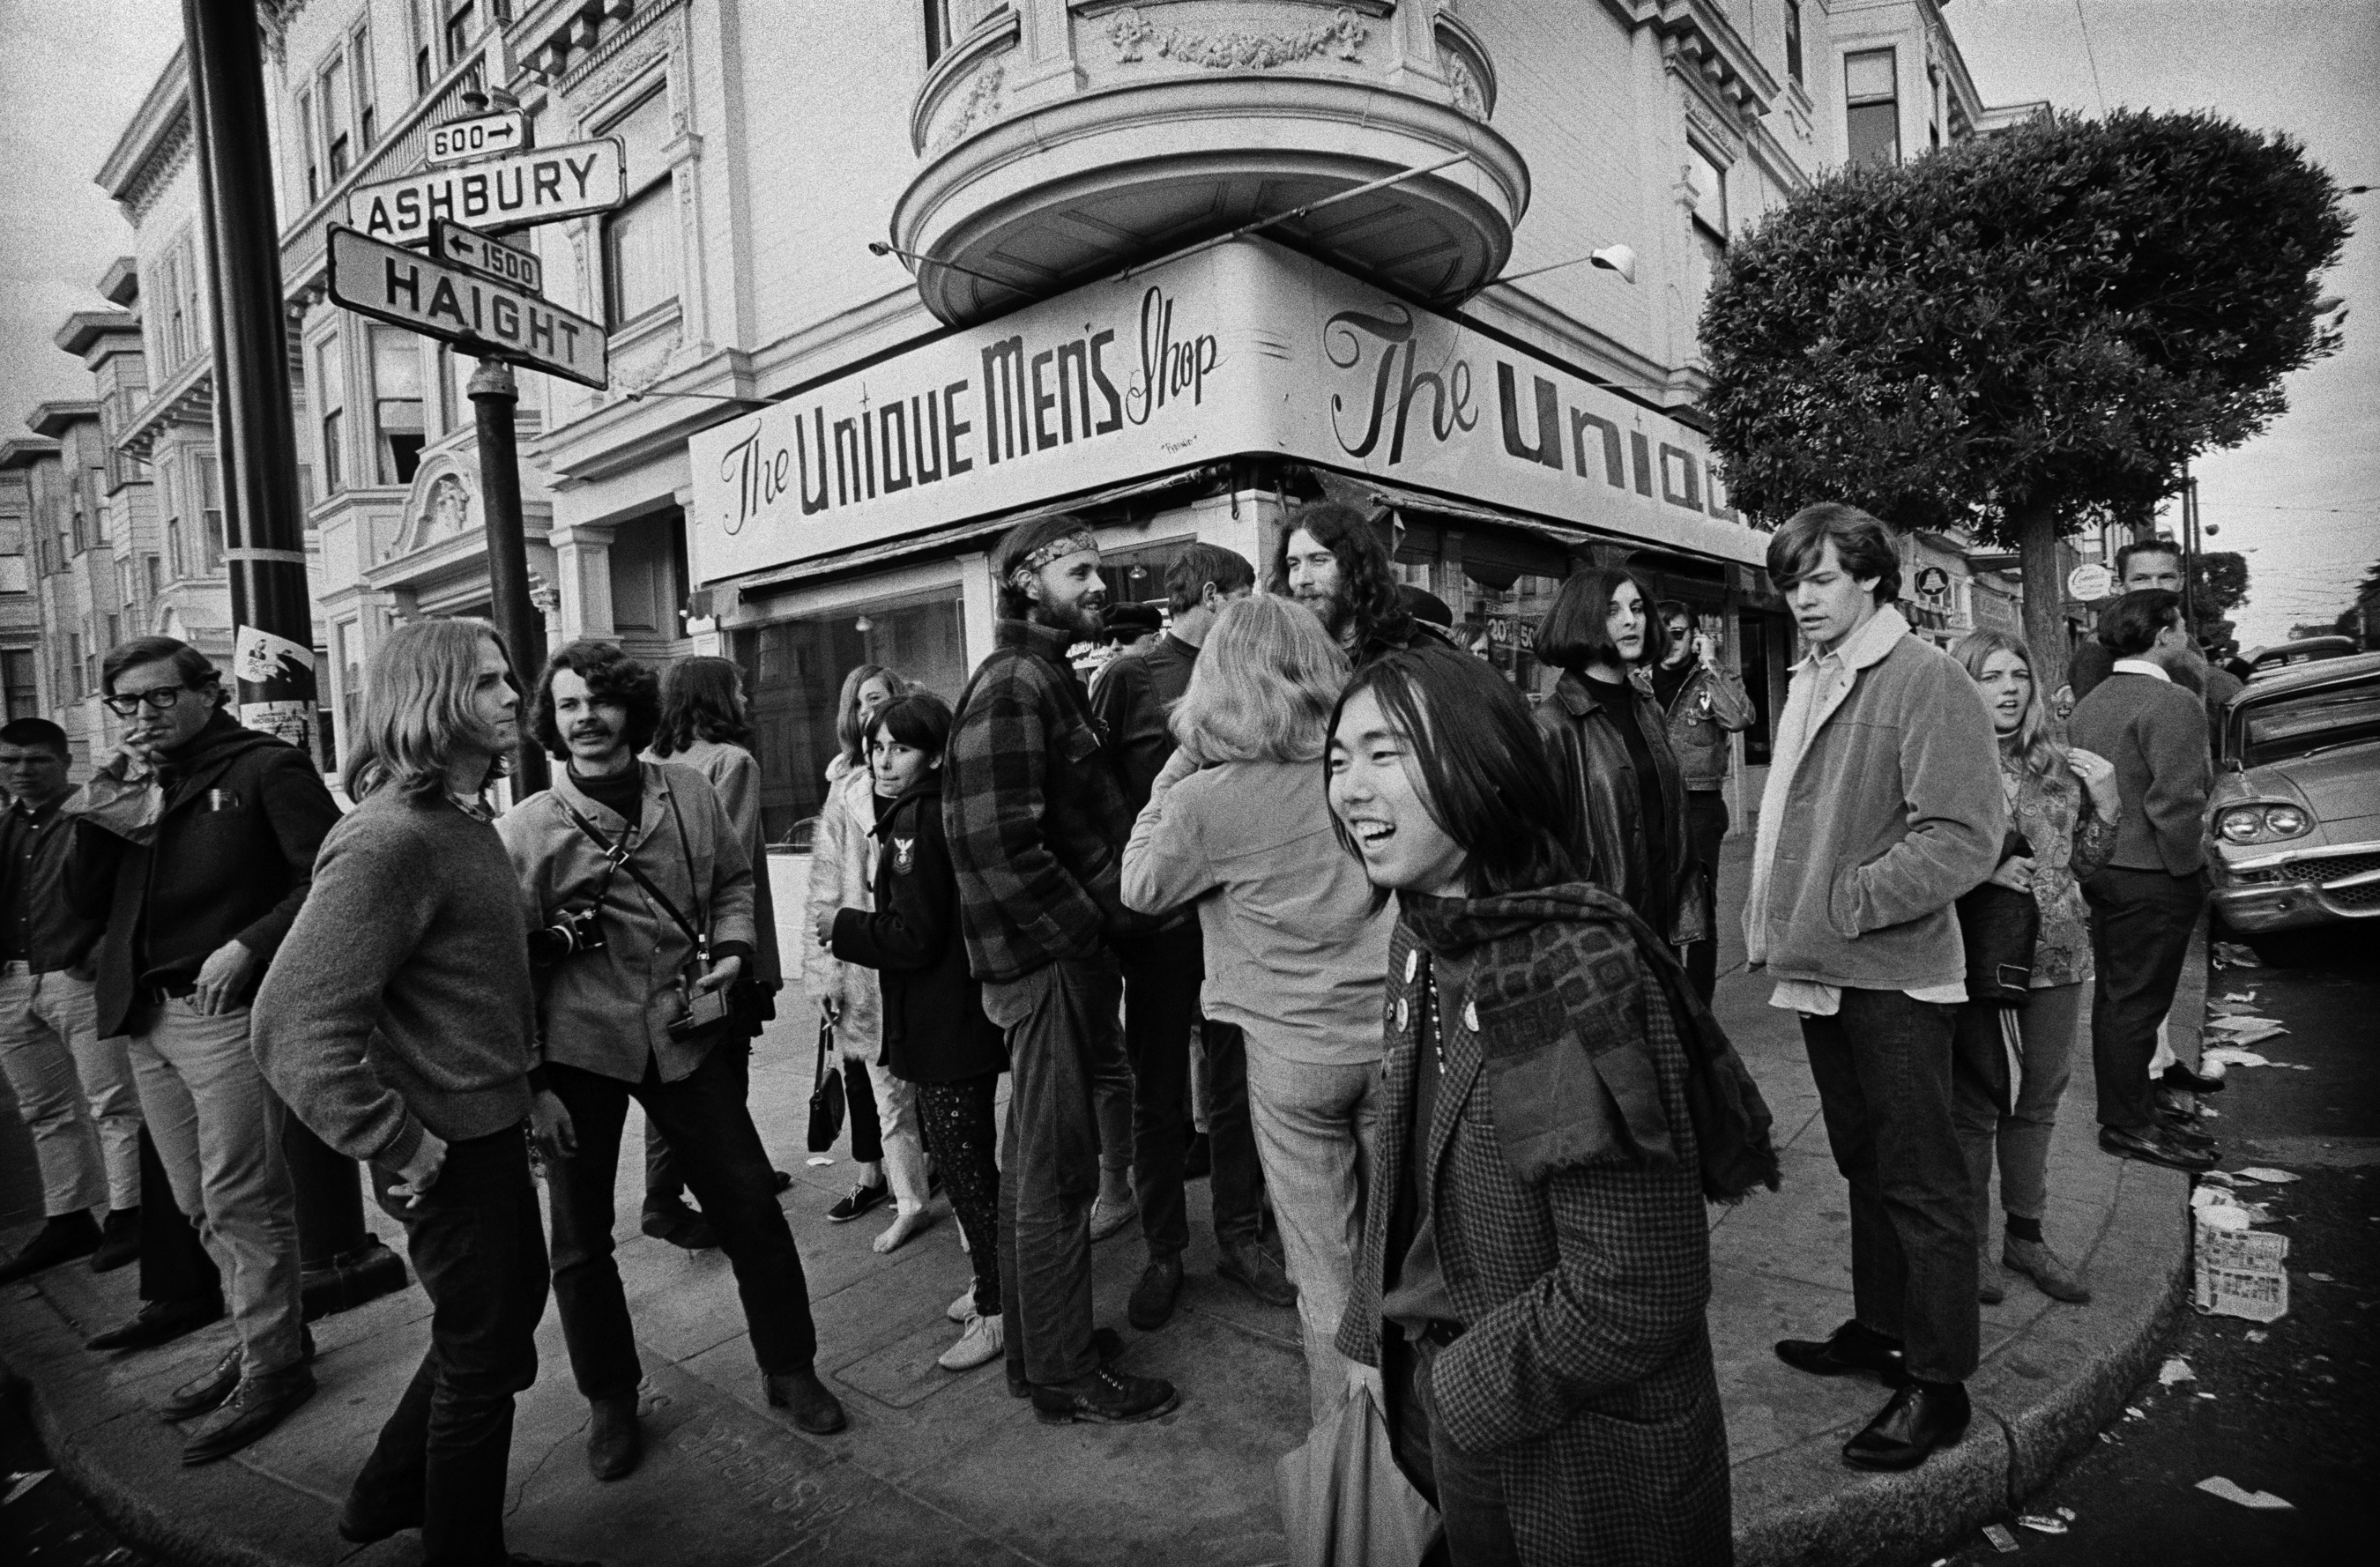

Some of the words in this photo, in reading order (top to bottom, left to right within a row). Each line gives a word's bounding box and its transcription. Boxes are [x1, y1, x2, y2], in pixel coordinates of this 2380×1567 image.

[434, 124, 485, 156] 600
[366, 152, 599, 235] ASHBURY
[384, 256, 580, 365] HAIGHT
[481, 241, 534, 286] 1500
[720, 416, 790, 536] The
[1125, 285, 1231, 426] Shop
[1324, 301, 1479, 467] The
